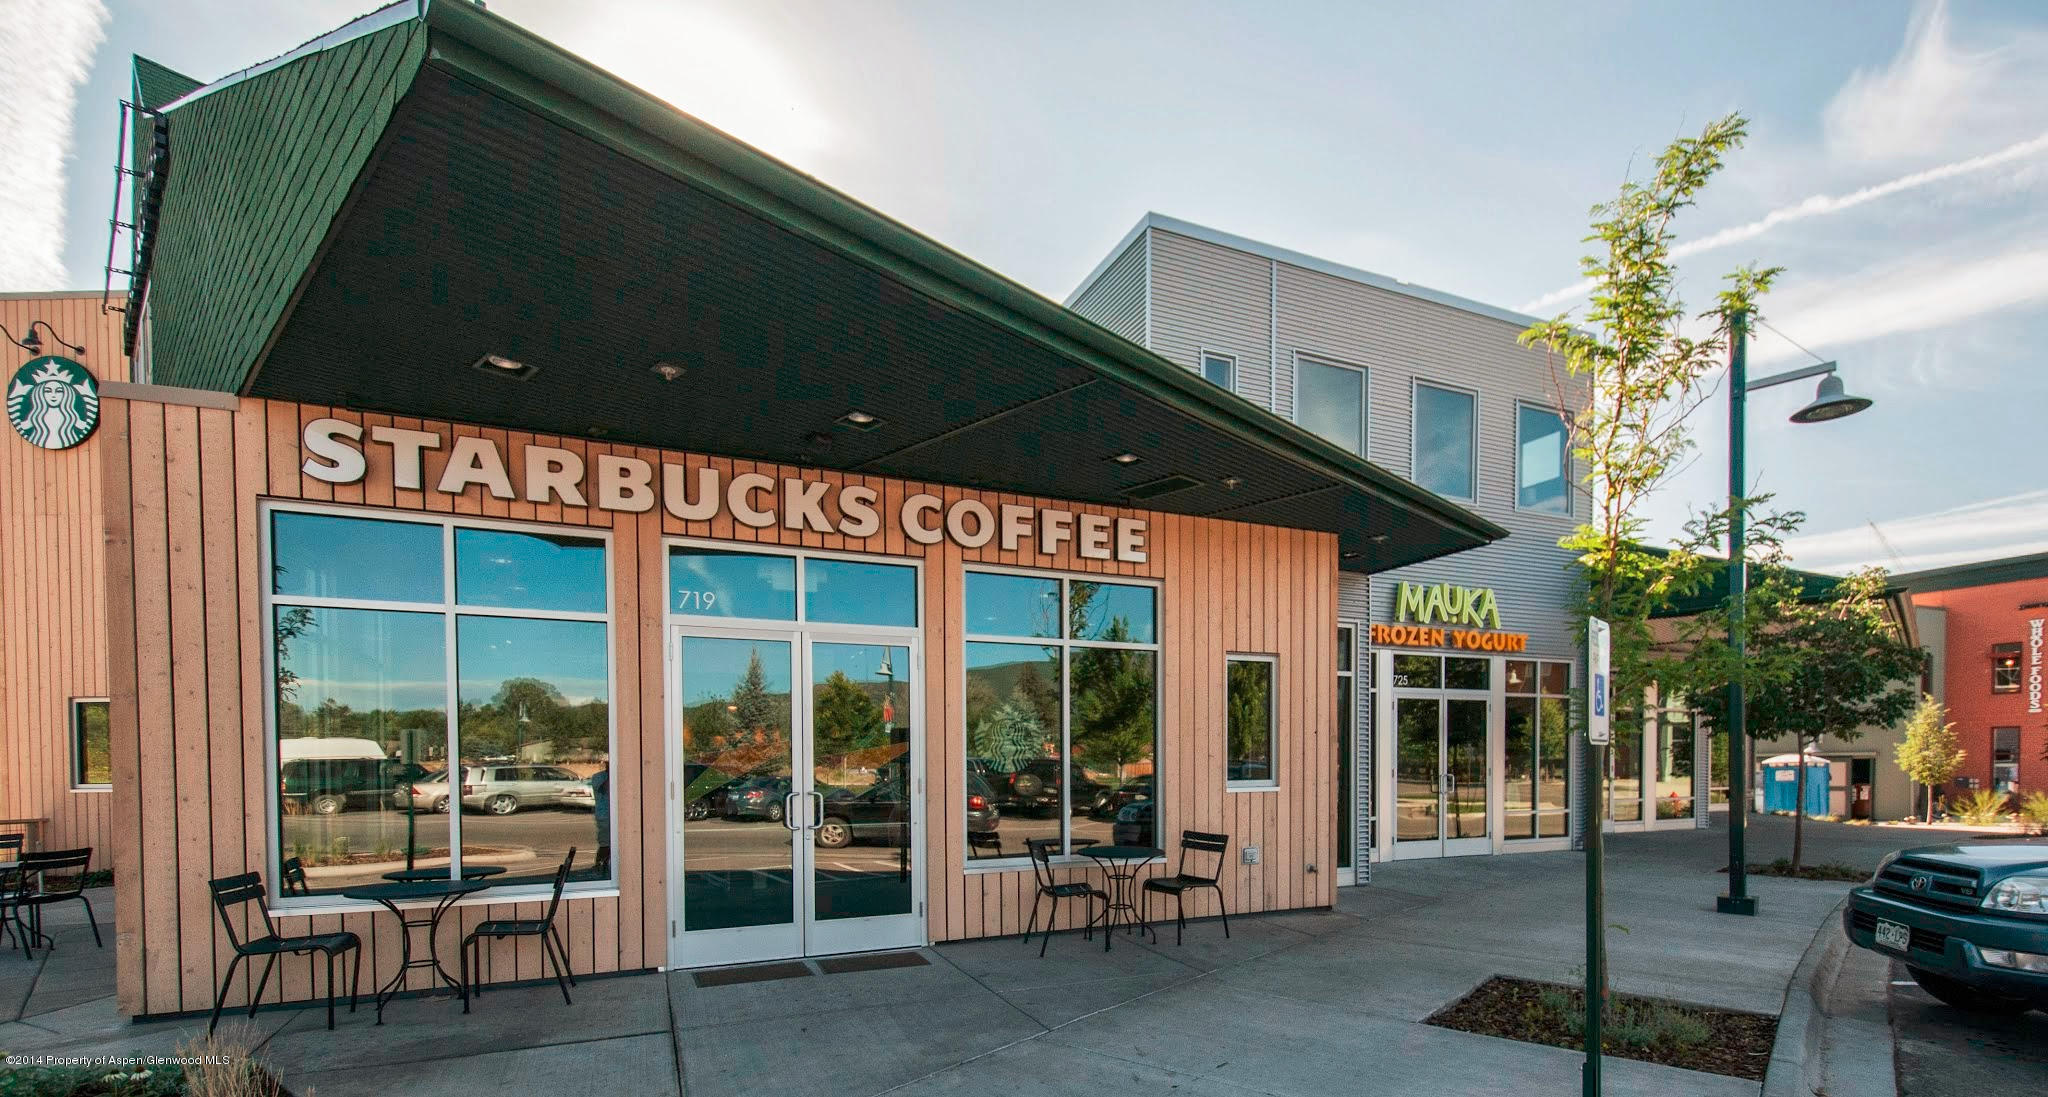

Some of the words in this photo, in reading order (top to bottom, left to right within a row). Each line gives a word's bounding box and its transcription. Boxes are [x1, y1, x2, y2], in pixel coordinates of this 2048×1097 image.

[302, 418, 881, 538] STARBUCKS
[900, 493, 1148, 564] COFFEE
[678, 590, 716, 610] 719
[1395, 581, 1501, 629] MAUKA
[1452, 629, 1528, 652] YOGURT
[2029, 619, 2045, 665] WHOLE
[1393, 674, 1409, 686] 725
[2028, 666, 2042, 713] FOODS
